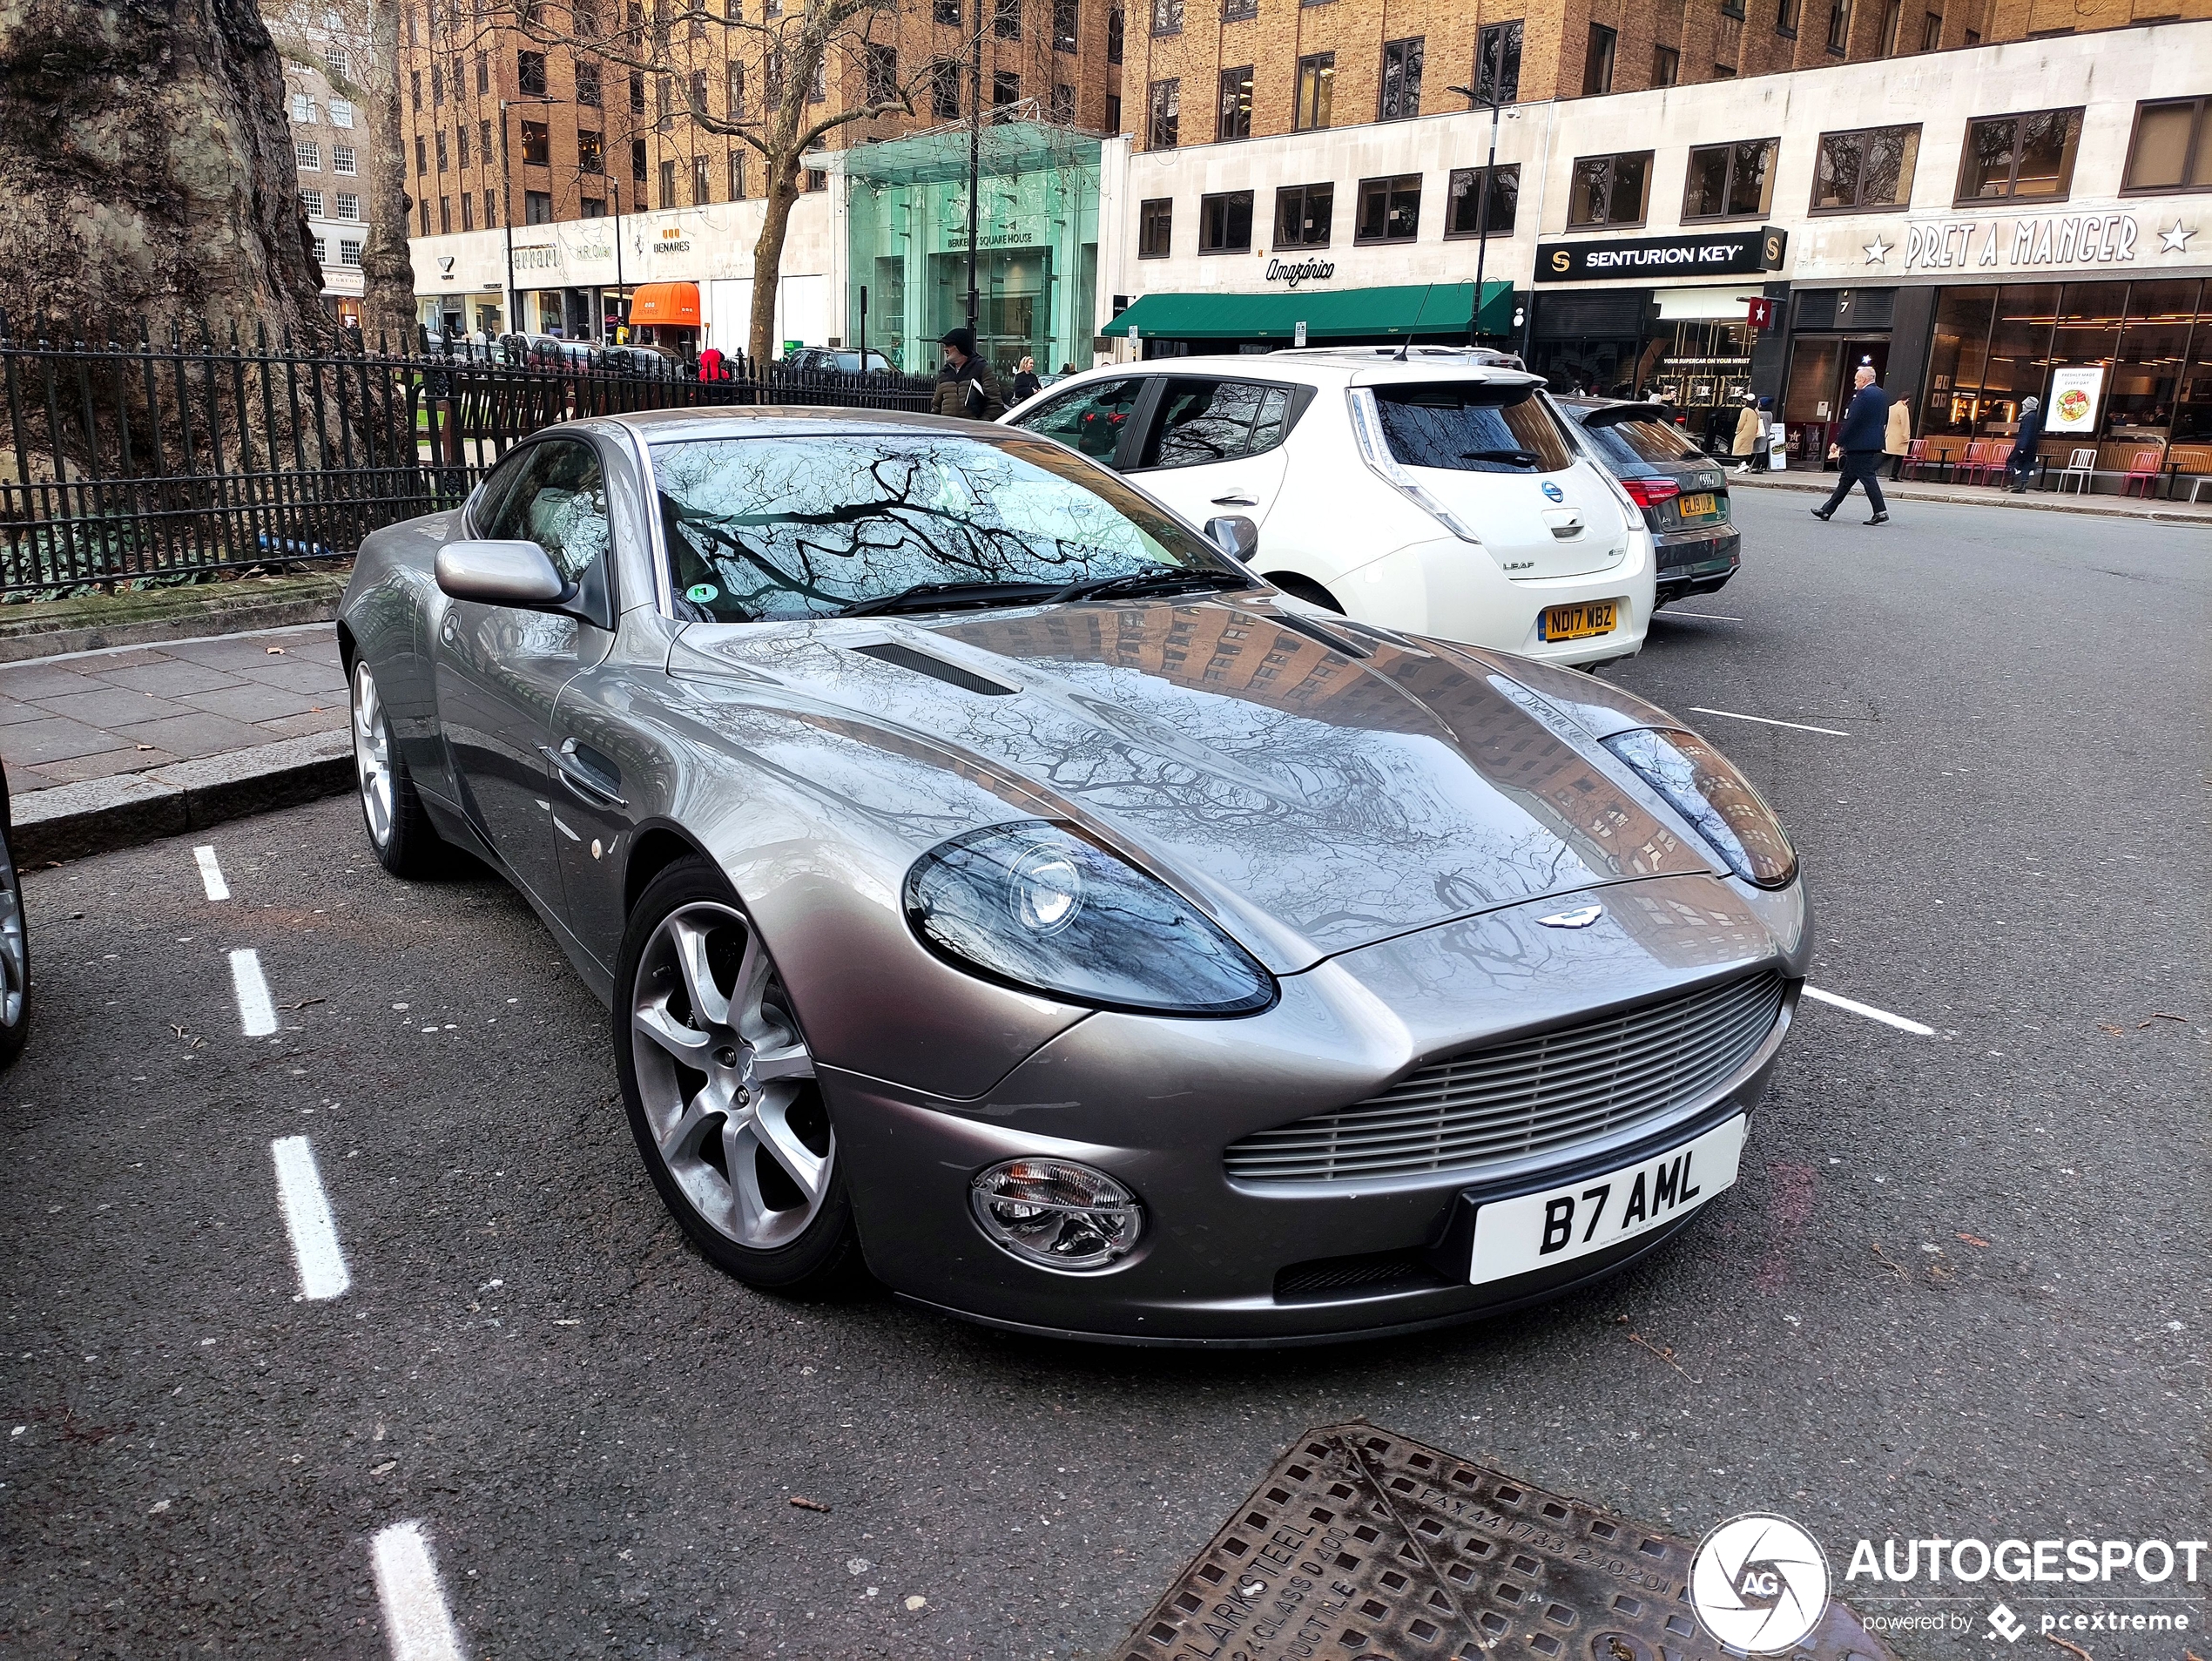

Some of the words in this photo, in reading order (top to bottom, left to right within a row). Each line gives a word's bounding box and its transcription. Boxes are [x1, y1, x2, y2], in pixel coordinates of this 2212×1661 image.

[653, 241, 690, 253] BENARES
[980, 234, 1007, 246] SQUARE
[1008, 233, 1032, 243] HOUSE
[1905, 224, 1976, 268] PRET
[1979, 222, 1998, 267] A
[2010, 215, 2138, 265] MANGER
[511, 245, 559, 270] errari
[1586, 248, 1697, 267] SENTURION
[1698, 246, 1741, 262] KEY
[1266, 257, 1335, 287] Amazónico
[1840, 302, 1849, 314] 7
[1503, 562, 1534, 571] LEAF
[1551, 608, 1583, 634] ND17
[1587, 604, 1612, 629] WBZ
[1539, 1183, 1611, 1256] B7
[1622, 1150, 1700, 1230] AML
[1420, 1489, 1467, 1516] FAX
